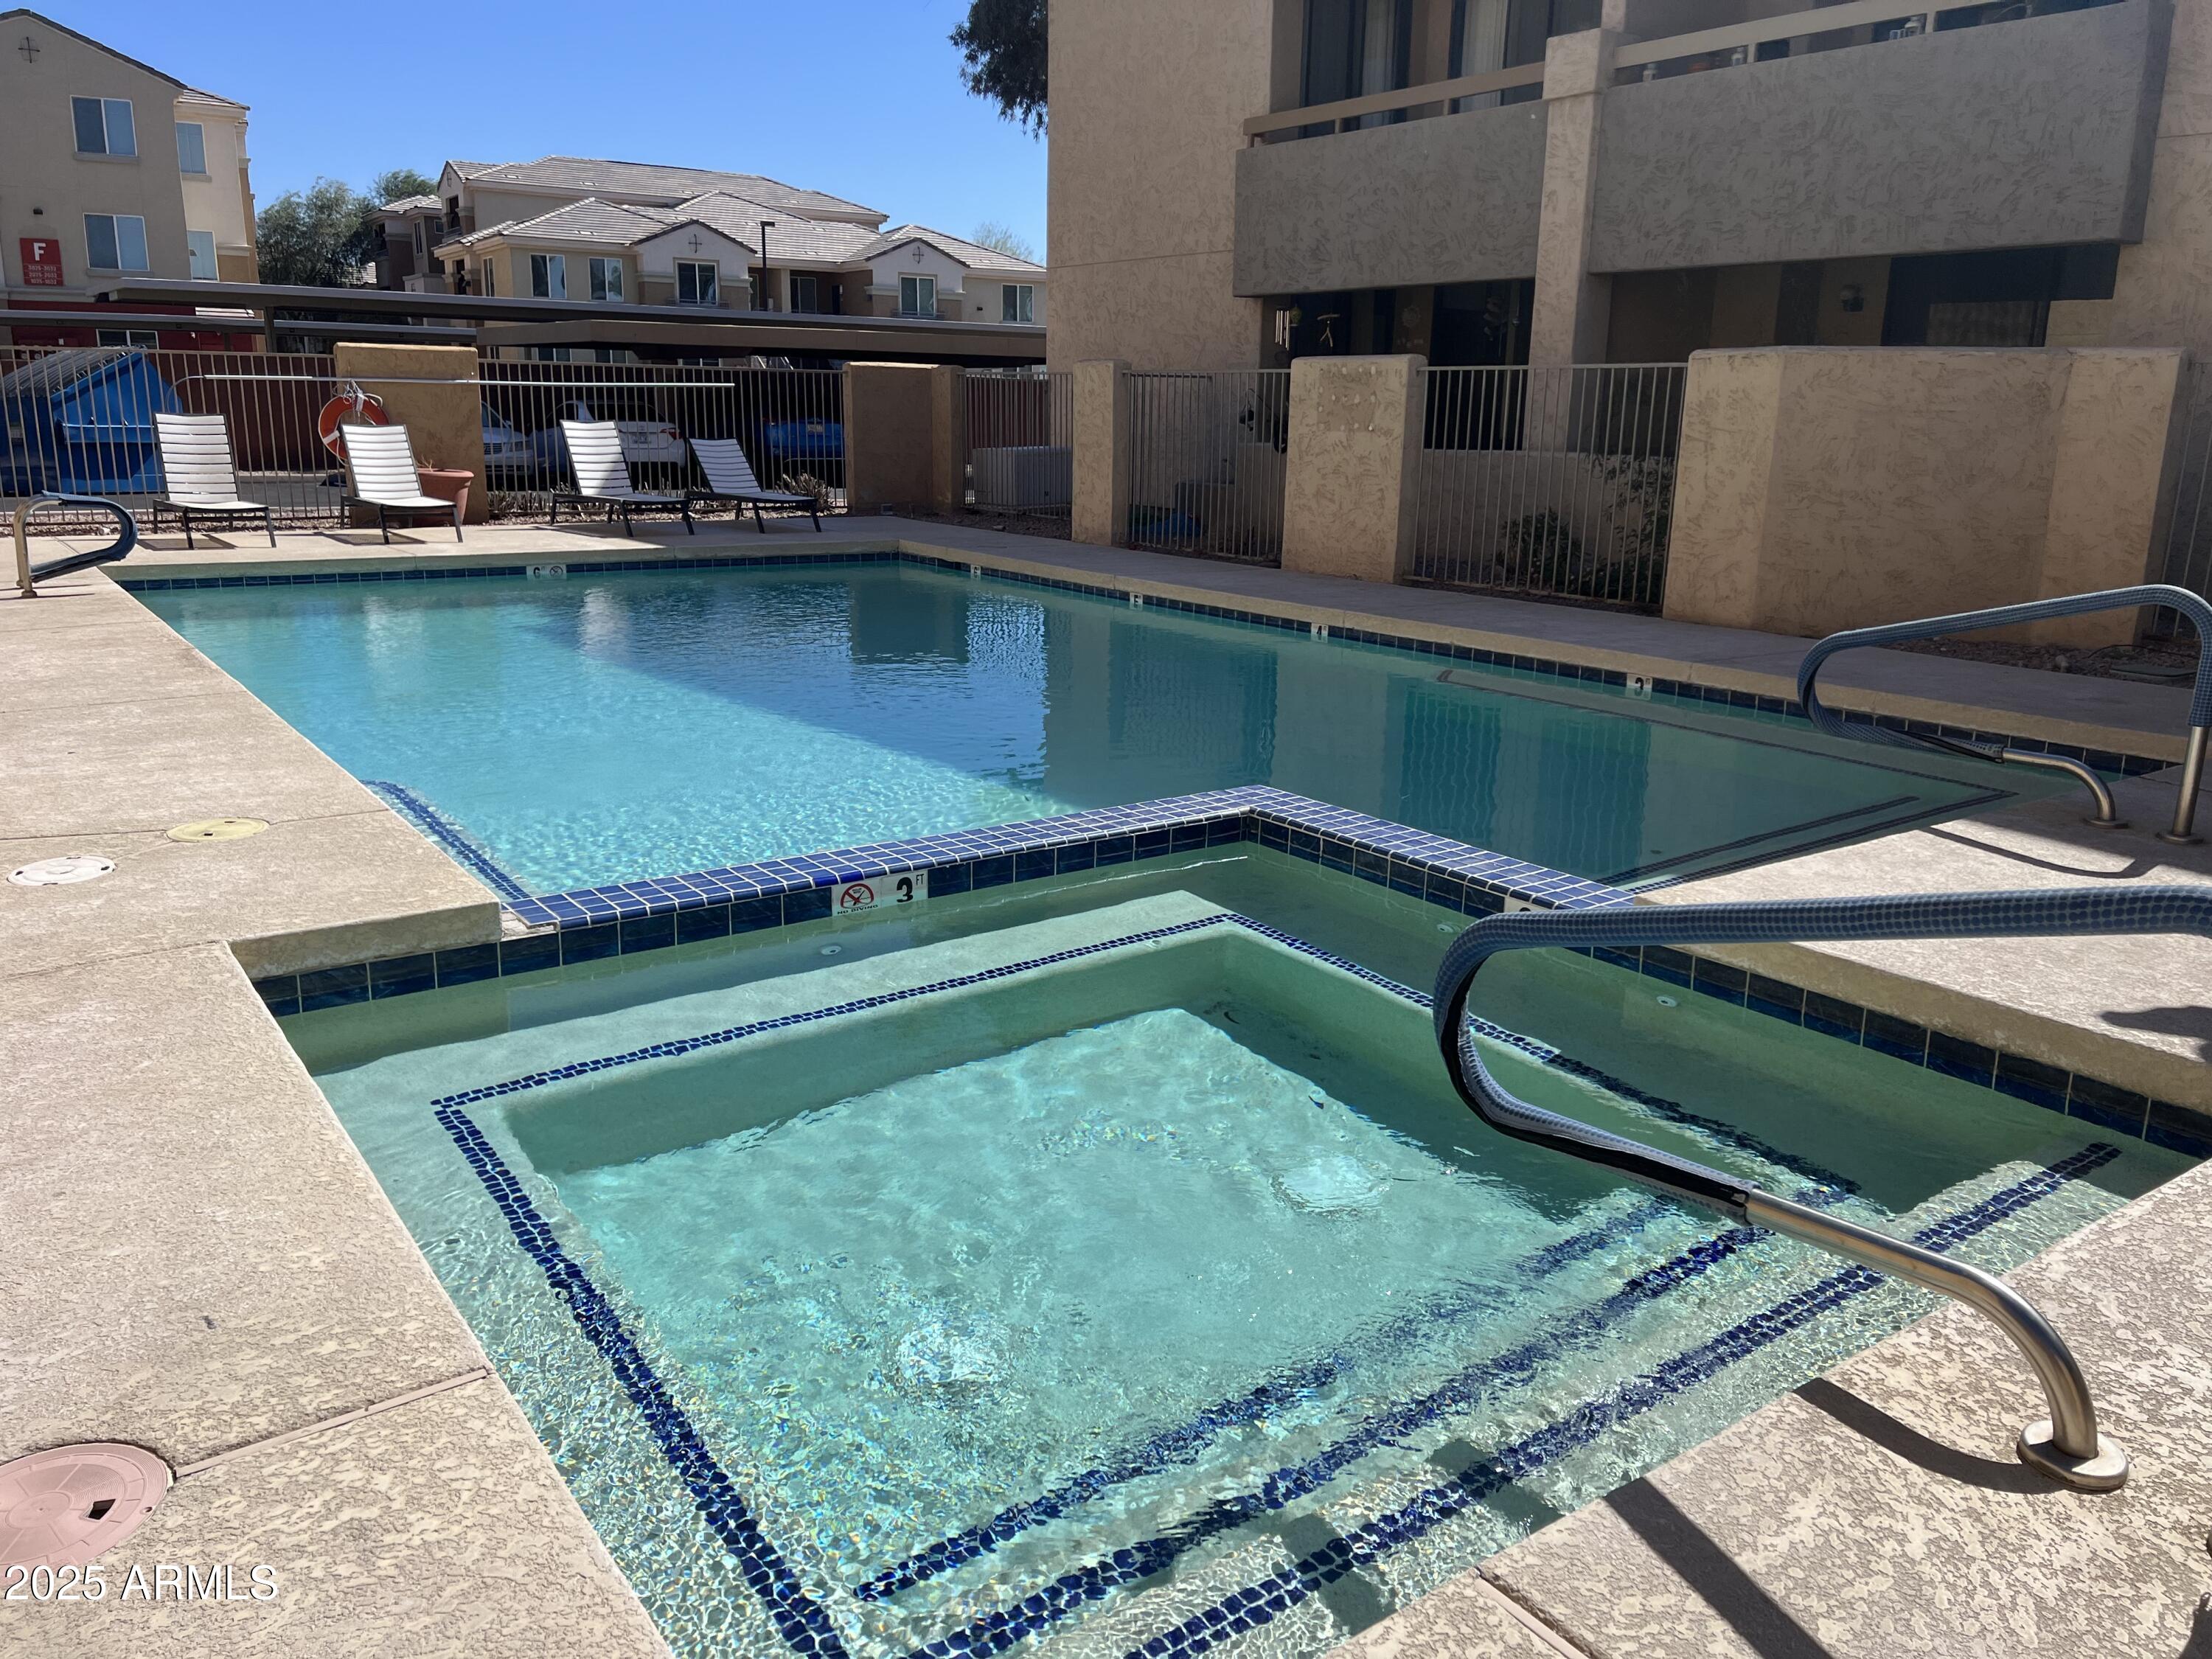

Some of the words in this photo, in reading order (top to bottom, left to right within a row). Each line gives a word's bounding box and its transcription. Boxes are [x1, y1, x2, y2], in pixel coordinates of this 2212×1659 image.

[33, 242, 46, 261] F
[896, 877, 914, 903] 3
[916, 874, 925, 886] FT
[851, 904, 878, 913] DIVING
